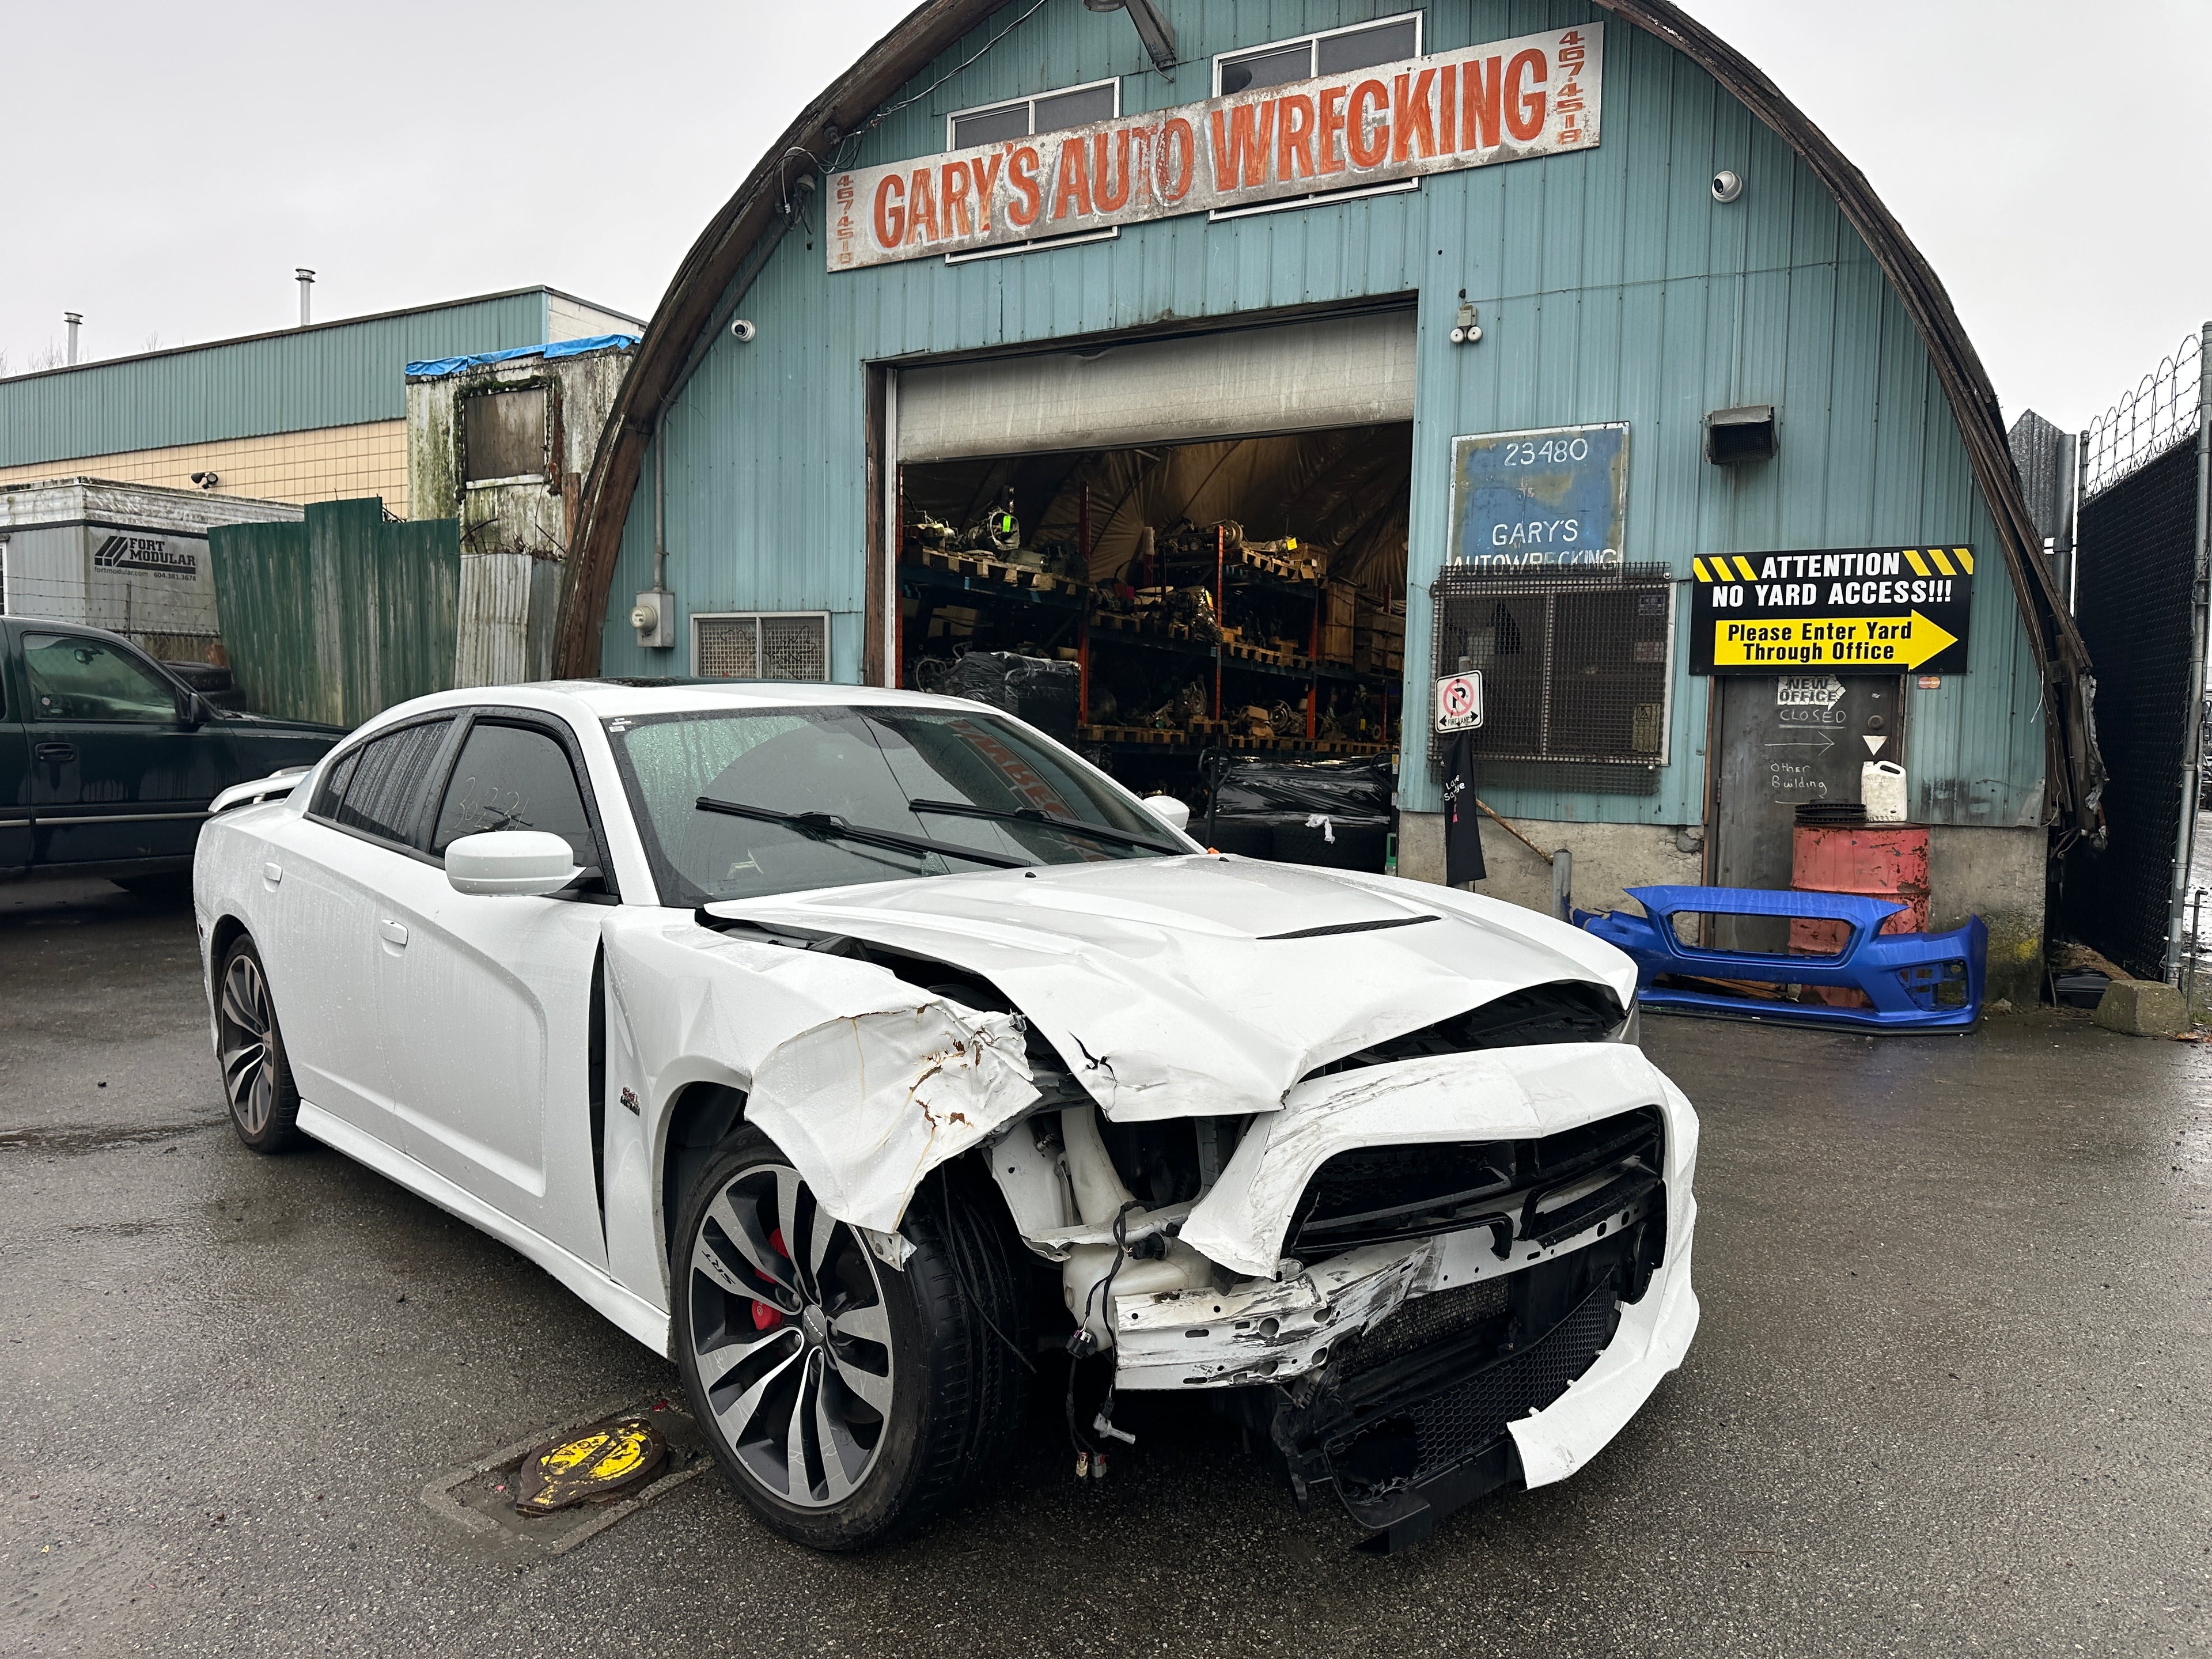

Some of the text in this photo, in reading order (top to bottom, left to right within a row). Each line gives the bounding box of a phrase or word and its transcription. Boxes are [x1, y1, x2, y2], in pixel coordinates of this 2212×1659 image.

[873, 48, 1548, 249] GARY'S AUTO WRECKING
[1504, 438, 1588, 466] 23480
[1492, 519, 1578, 546] GARY'S
[130, 537, 165, 551] FORT
[130, 549, 196, 566] MODULAR
[1760, 552, 1900, 579] ATTENTION
[94, 566, 148, 577] fortmodular.com
[1712, 579, 1952, 607] NO YARD ACCESS!!!
[1728, 622, 1912, 642] Please Enter Yard
[1743, 642, 1894, 663] Through Office
[1787, 679, 1828, 690] NEW
[1779, 690, 1837, 702] OFFICE
[1780, 709, 1846, 723] CLOSED
[1771, 775, 1827, 796] Building
[701, 1250, 736, 1285] SRT
